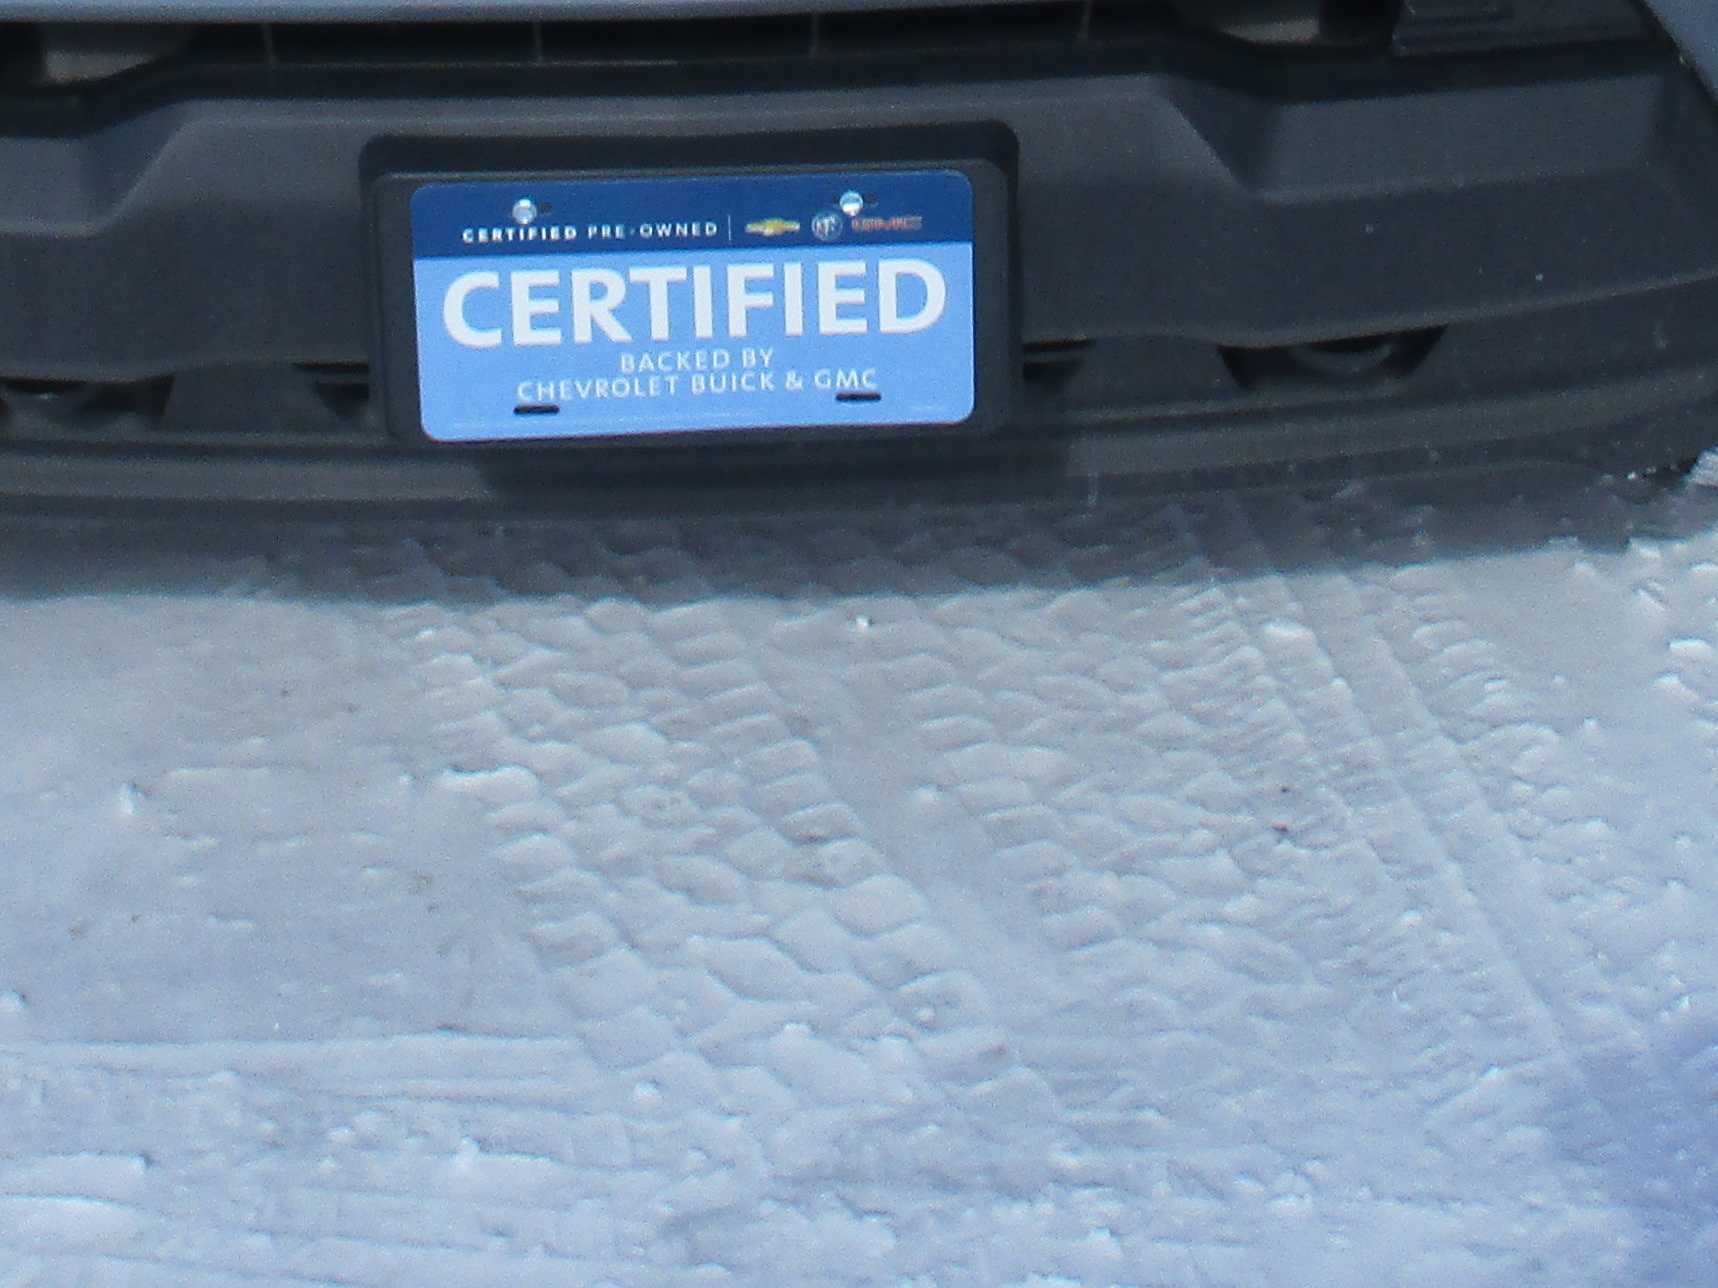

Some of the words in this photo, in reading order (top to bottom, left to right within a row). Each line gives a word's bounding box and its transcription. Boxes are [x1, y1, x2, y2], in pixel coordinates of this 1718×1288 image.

[461, 225, 577, 244] CERTIFIED
[442, 258, 947, 349] CERTIFIED
[620, 349, 731, 374] BACKED
[742, 346, 775, 368] BY
[517, 376, 680, 403] CHEVROLET
[691, 371, 776, 393] BUICK
[785, 370, 804, 391] &
[815, 368, 878, 391] GMC
